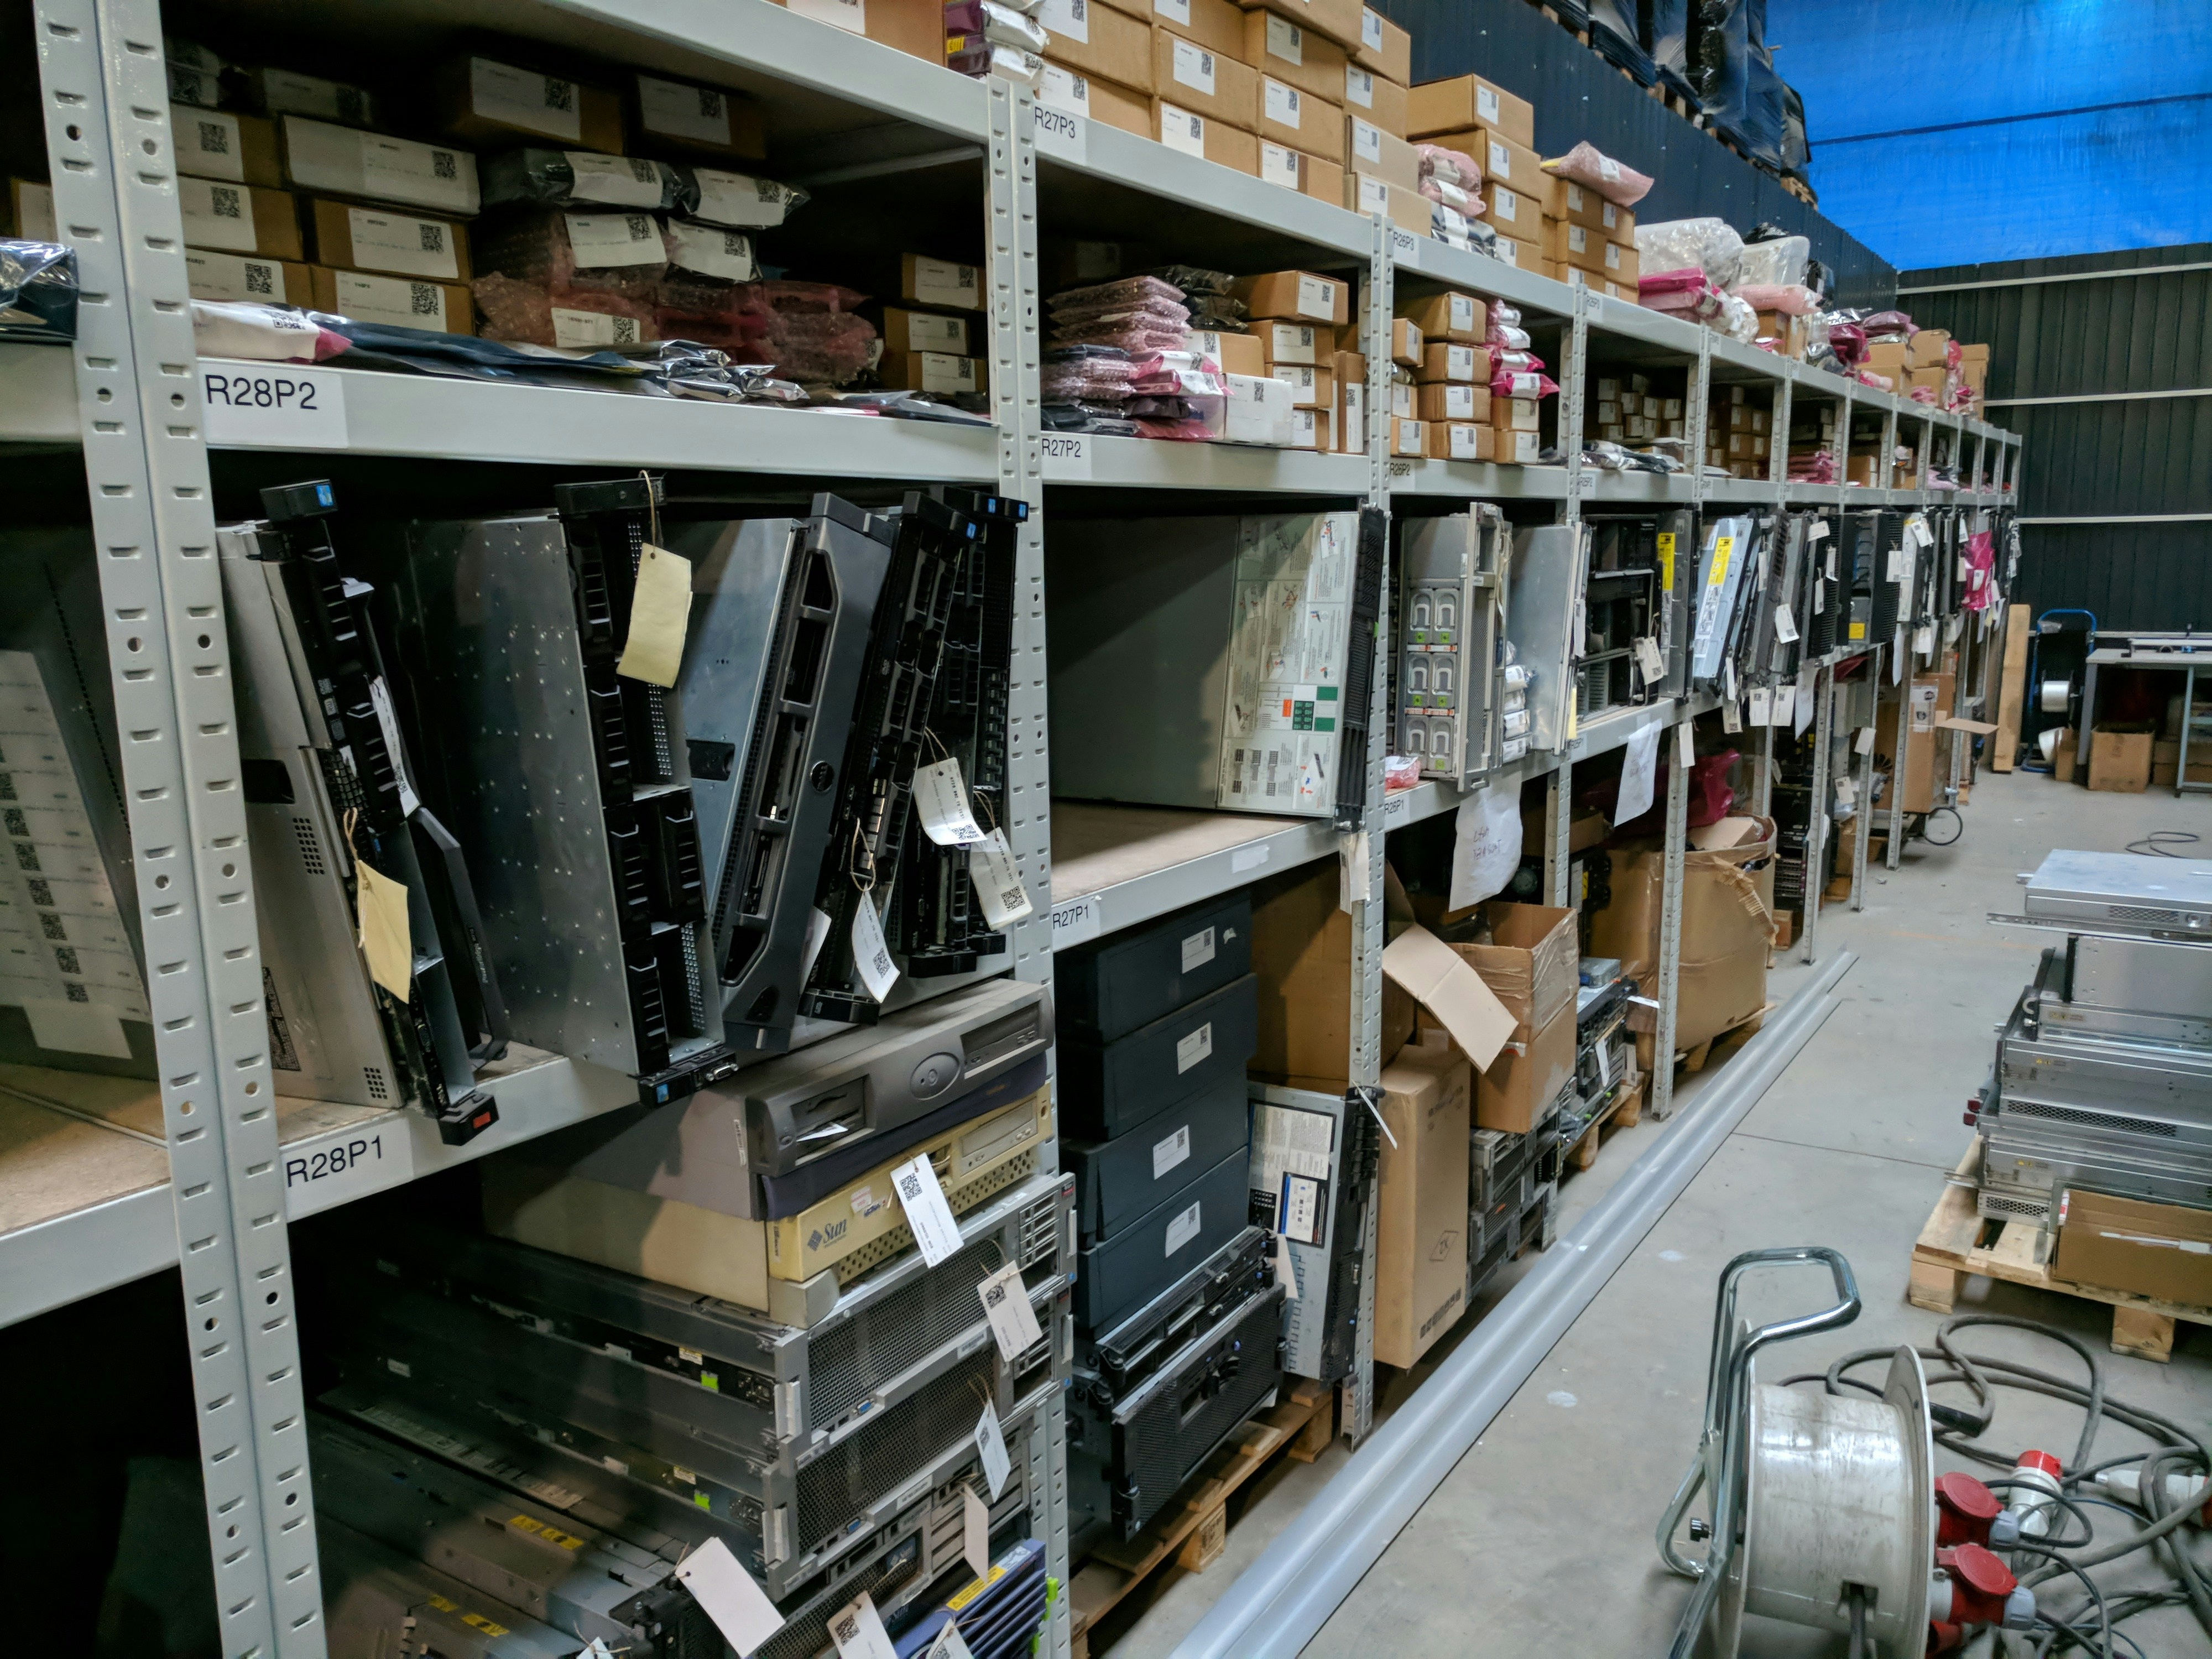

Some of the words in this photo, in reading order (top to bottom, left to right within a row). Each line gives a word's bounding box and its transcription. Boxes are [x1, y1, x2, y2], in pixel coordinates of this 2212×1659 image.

[1035, 106, 1076, 138] R27P3
[1394, 231, 1414, 251] R26P3
[205, 374, 318, 410] R28P2
[1042, 438, 1081, 457] R27P2
[1390, 462, 1410, 476] R26P2
[1384, 799, 1404, 815] R26P1
[1053, 904, 1088, 930] R27P1
[286, 1135, 382, 1188] R28P1
[823, 1219, 847, 1243] Sun
